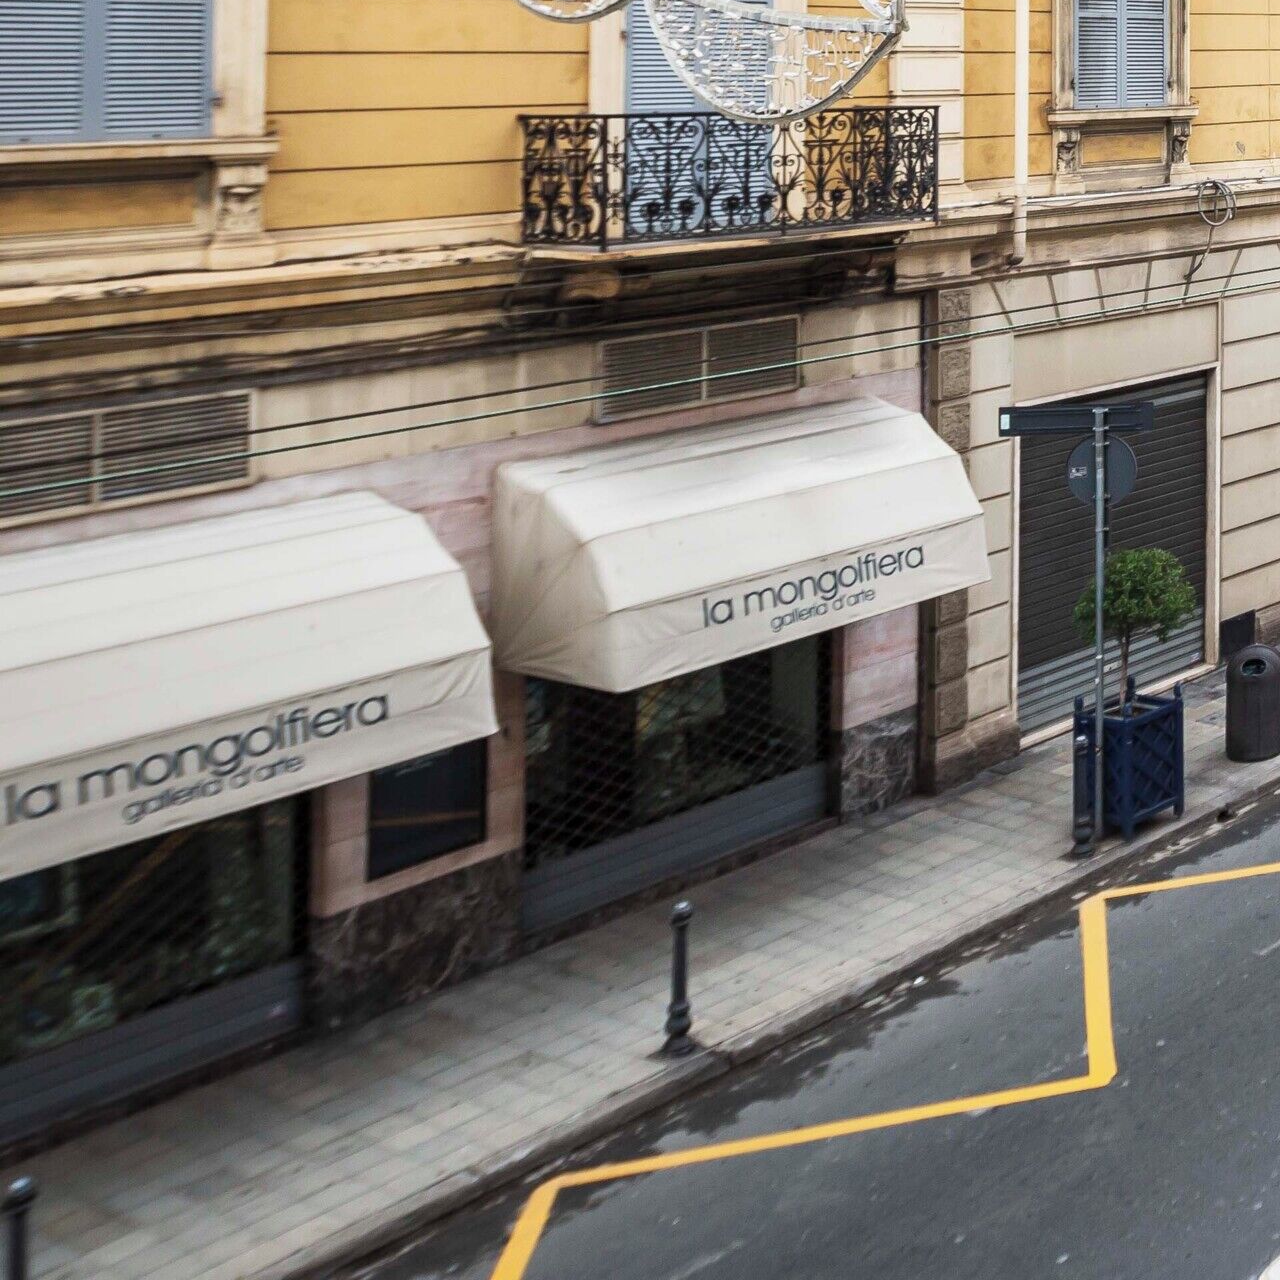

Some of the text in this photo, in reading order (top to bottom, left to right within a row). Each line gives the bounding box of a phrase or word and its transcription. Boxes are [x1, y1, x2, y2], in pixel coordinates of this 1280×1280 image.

[702, 545, 924, 627] la mongolfiera
[770, 588, 875, 633] galleria d'arte
[2, 694, 389, 824] la mongolfiera
[122, 754, 305, 825] galleria d'arte
